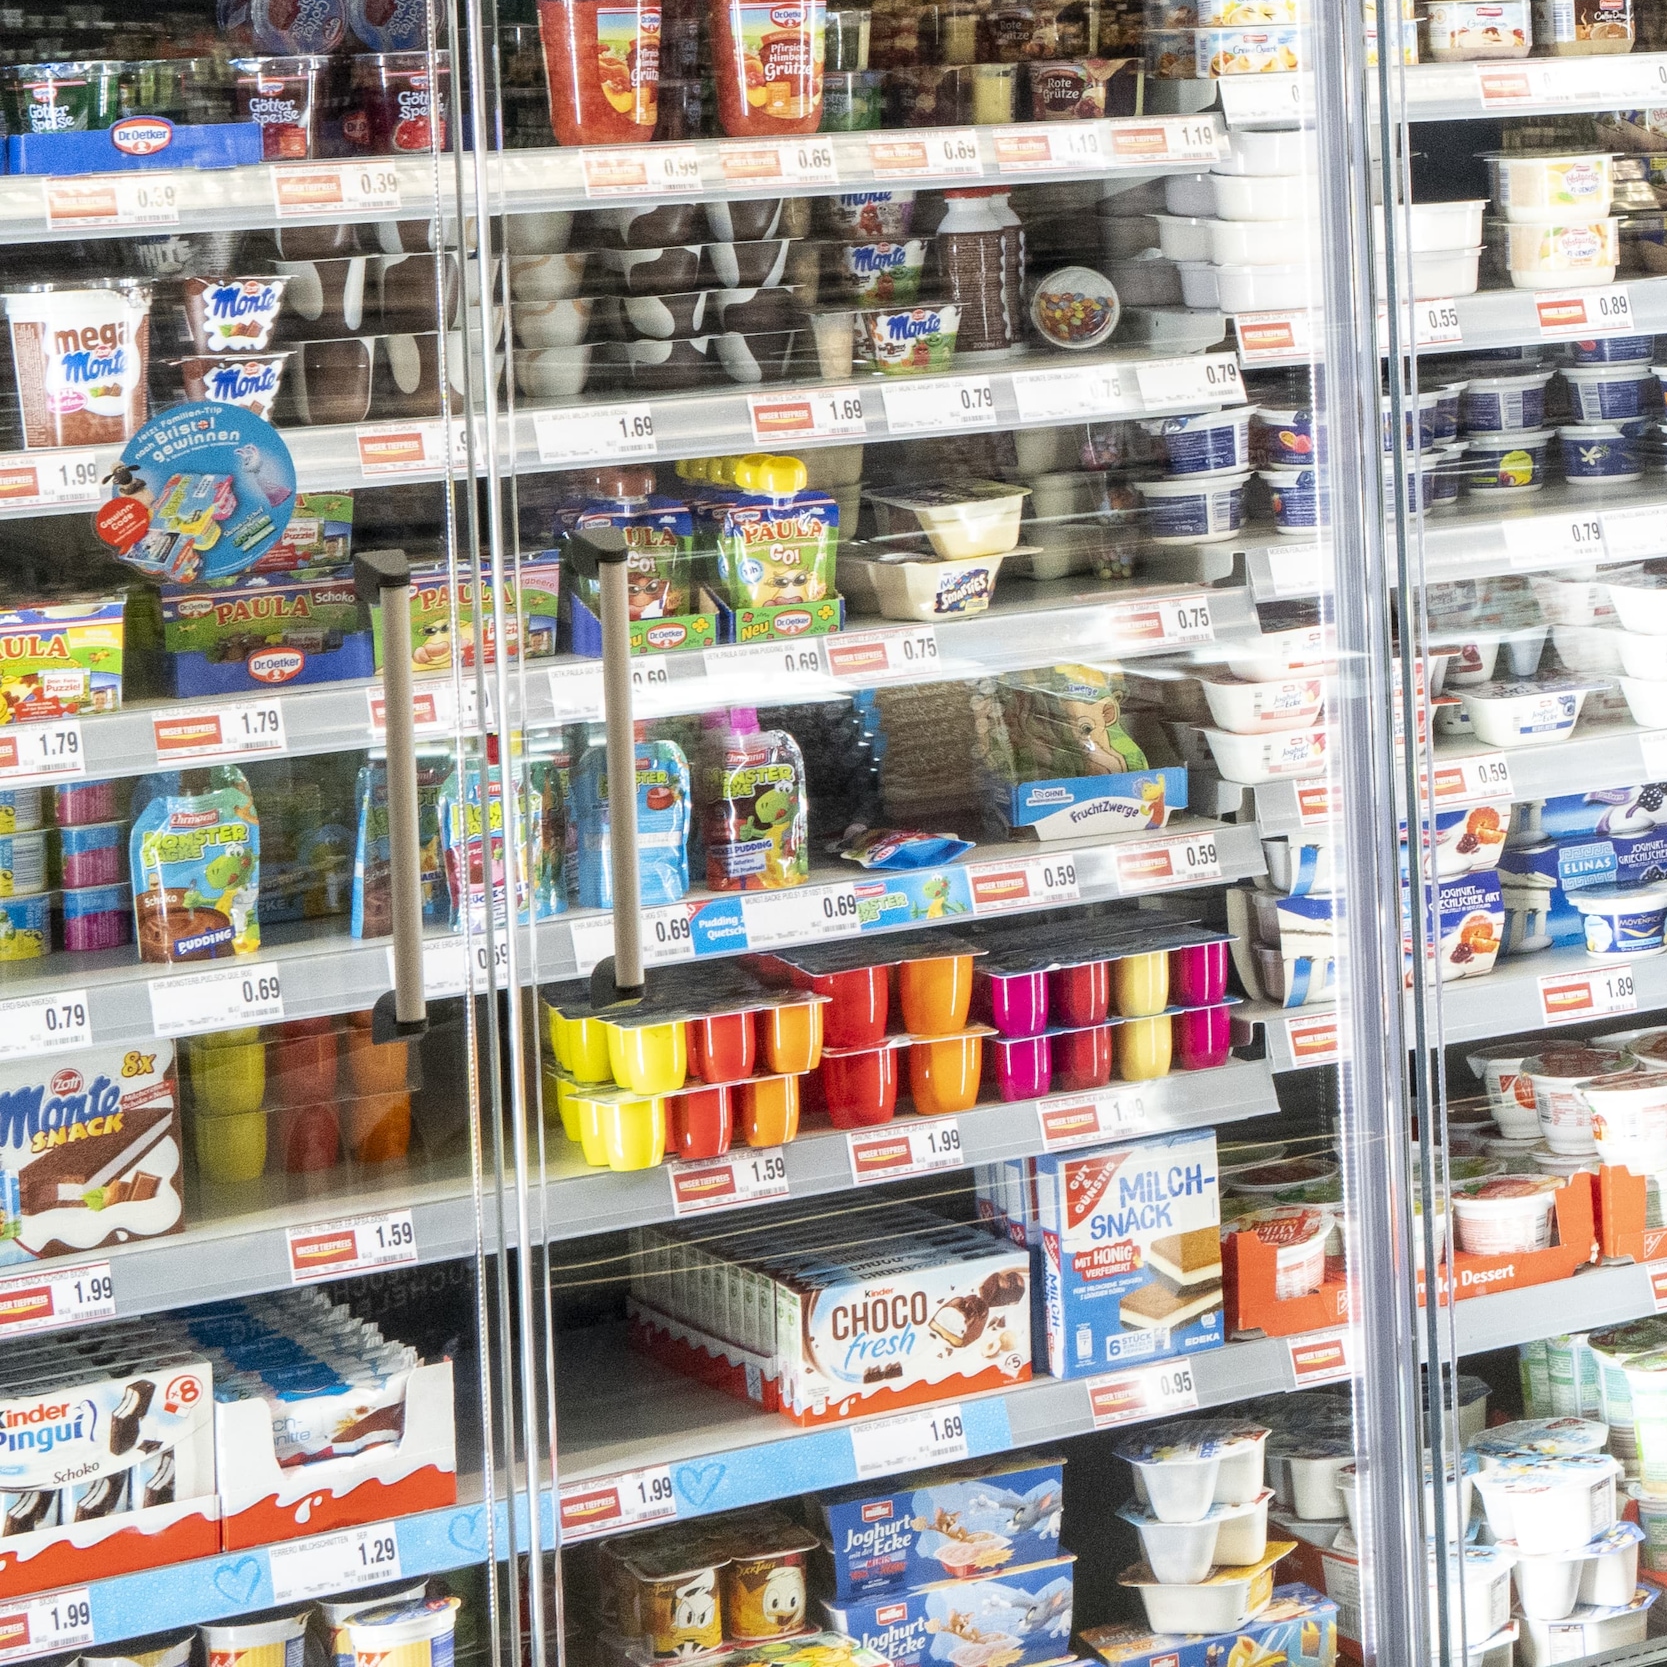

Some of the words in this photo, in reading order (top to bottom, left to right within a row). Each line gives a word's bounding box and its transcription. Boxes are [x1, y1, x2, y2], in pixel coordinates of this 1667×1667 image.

[249, 97, 296, 113] Götter
[118, 127, 169, 142] Dr.Oetker
[211, 284, 274, 317] Monte
[1599, 295, 1628, 316] 0.89
[54, 320, 131, 354] mega
[888, 315, 941, 340] Monte
[61, 350, 129, 384] Monte
[211, 365, 276, 399] Monte
[161, 407, 222, 428] Familien-Trip
[135, 442, 155, 461] nach
[153, 430, 240, 462] gewinnen
[111, 512, 135, 531] Code
[742, 519, 824, 544] PAULA
[769, 543, 800, 565] GO!
[217, 593, 310, 624] PAULA
[313, 590, 355, 605] Schoko
[741, 620, 770, 641] Neu
[776, 616, 810, 628] Dr.Oetker
[1178, 608, 1209, 630] 0.75
[903, 638, 937, 660] 0.75
[252, 656, 301, 672] Dr.Oetker
[158, 727, 181, 741] UNSER
[182, 722, 219, 739] TIEFPREIS
[1070, 800, 1139, 825] FruchtZwerge
[144, 824, 248, 850] MONSTER
[1563, 858, 1611, 874] ELINAS
[699, 914, 738, 928] Pudding
[243, 977, 280, 1002] 0.69
[1604, 975, 1635, 999] 1.89
[55, 1077, 78, 1090] Zott
[0, 1075, 121, 1149] Monte
[31, 1112, 125, 1153] SNACK
[751, 1158, 786, 1181] 1.59
[1069, 1164, 1091, 1191] GUT
[1074, 1161, 1116, 1215] GÜNSTIG
[1090, 1202, 1173, 1241] SNACK
[376, 1222, 413, 1247] 1.59
[296, 1244, 317, 1257] UNSER
[319, 1238, 353, 1255] TIEFPREIS
[1461, 1263, 1515, 1286] Dessert
[864, 1285, 894, 1299] kinder
[832, 1292, 928, 1337] CHOCO
[844, 1323, 916, 1363] fresh
[1109, 1340, 1120, 1356] 6
[1185, 1333, 1221, 1346] EDEKA
[1161, 1371, 1192, 1395] 0.95
[929, 1418, 963, 1441] 1.69
[53, 1460, 100, 1485] Schoko
[637, 1477, 673, 1502] 1.99
[843, 1515, 912, 1553] Joghurt
[873, 1532, 912, 1557] Ecke
[358, 1539, 395, 1565] 1.29
